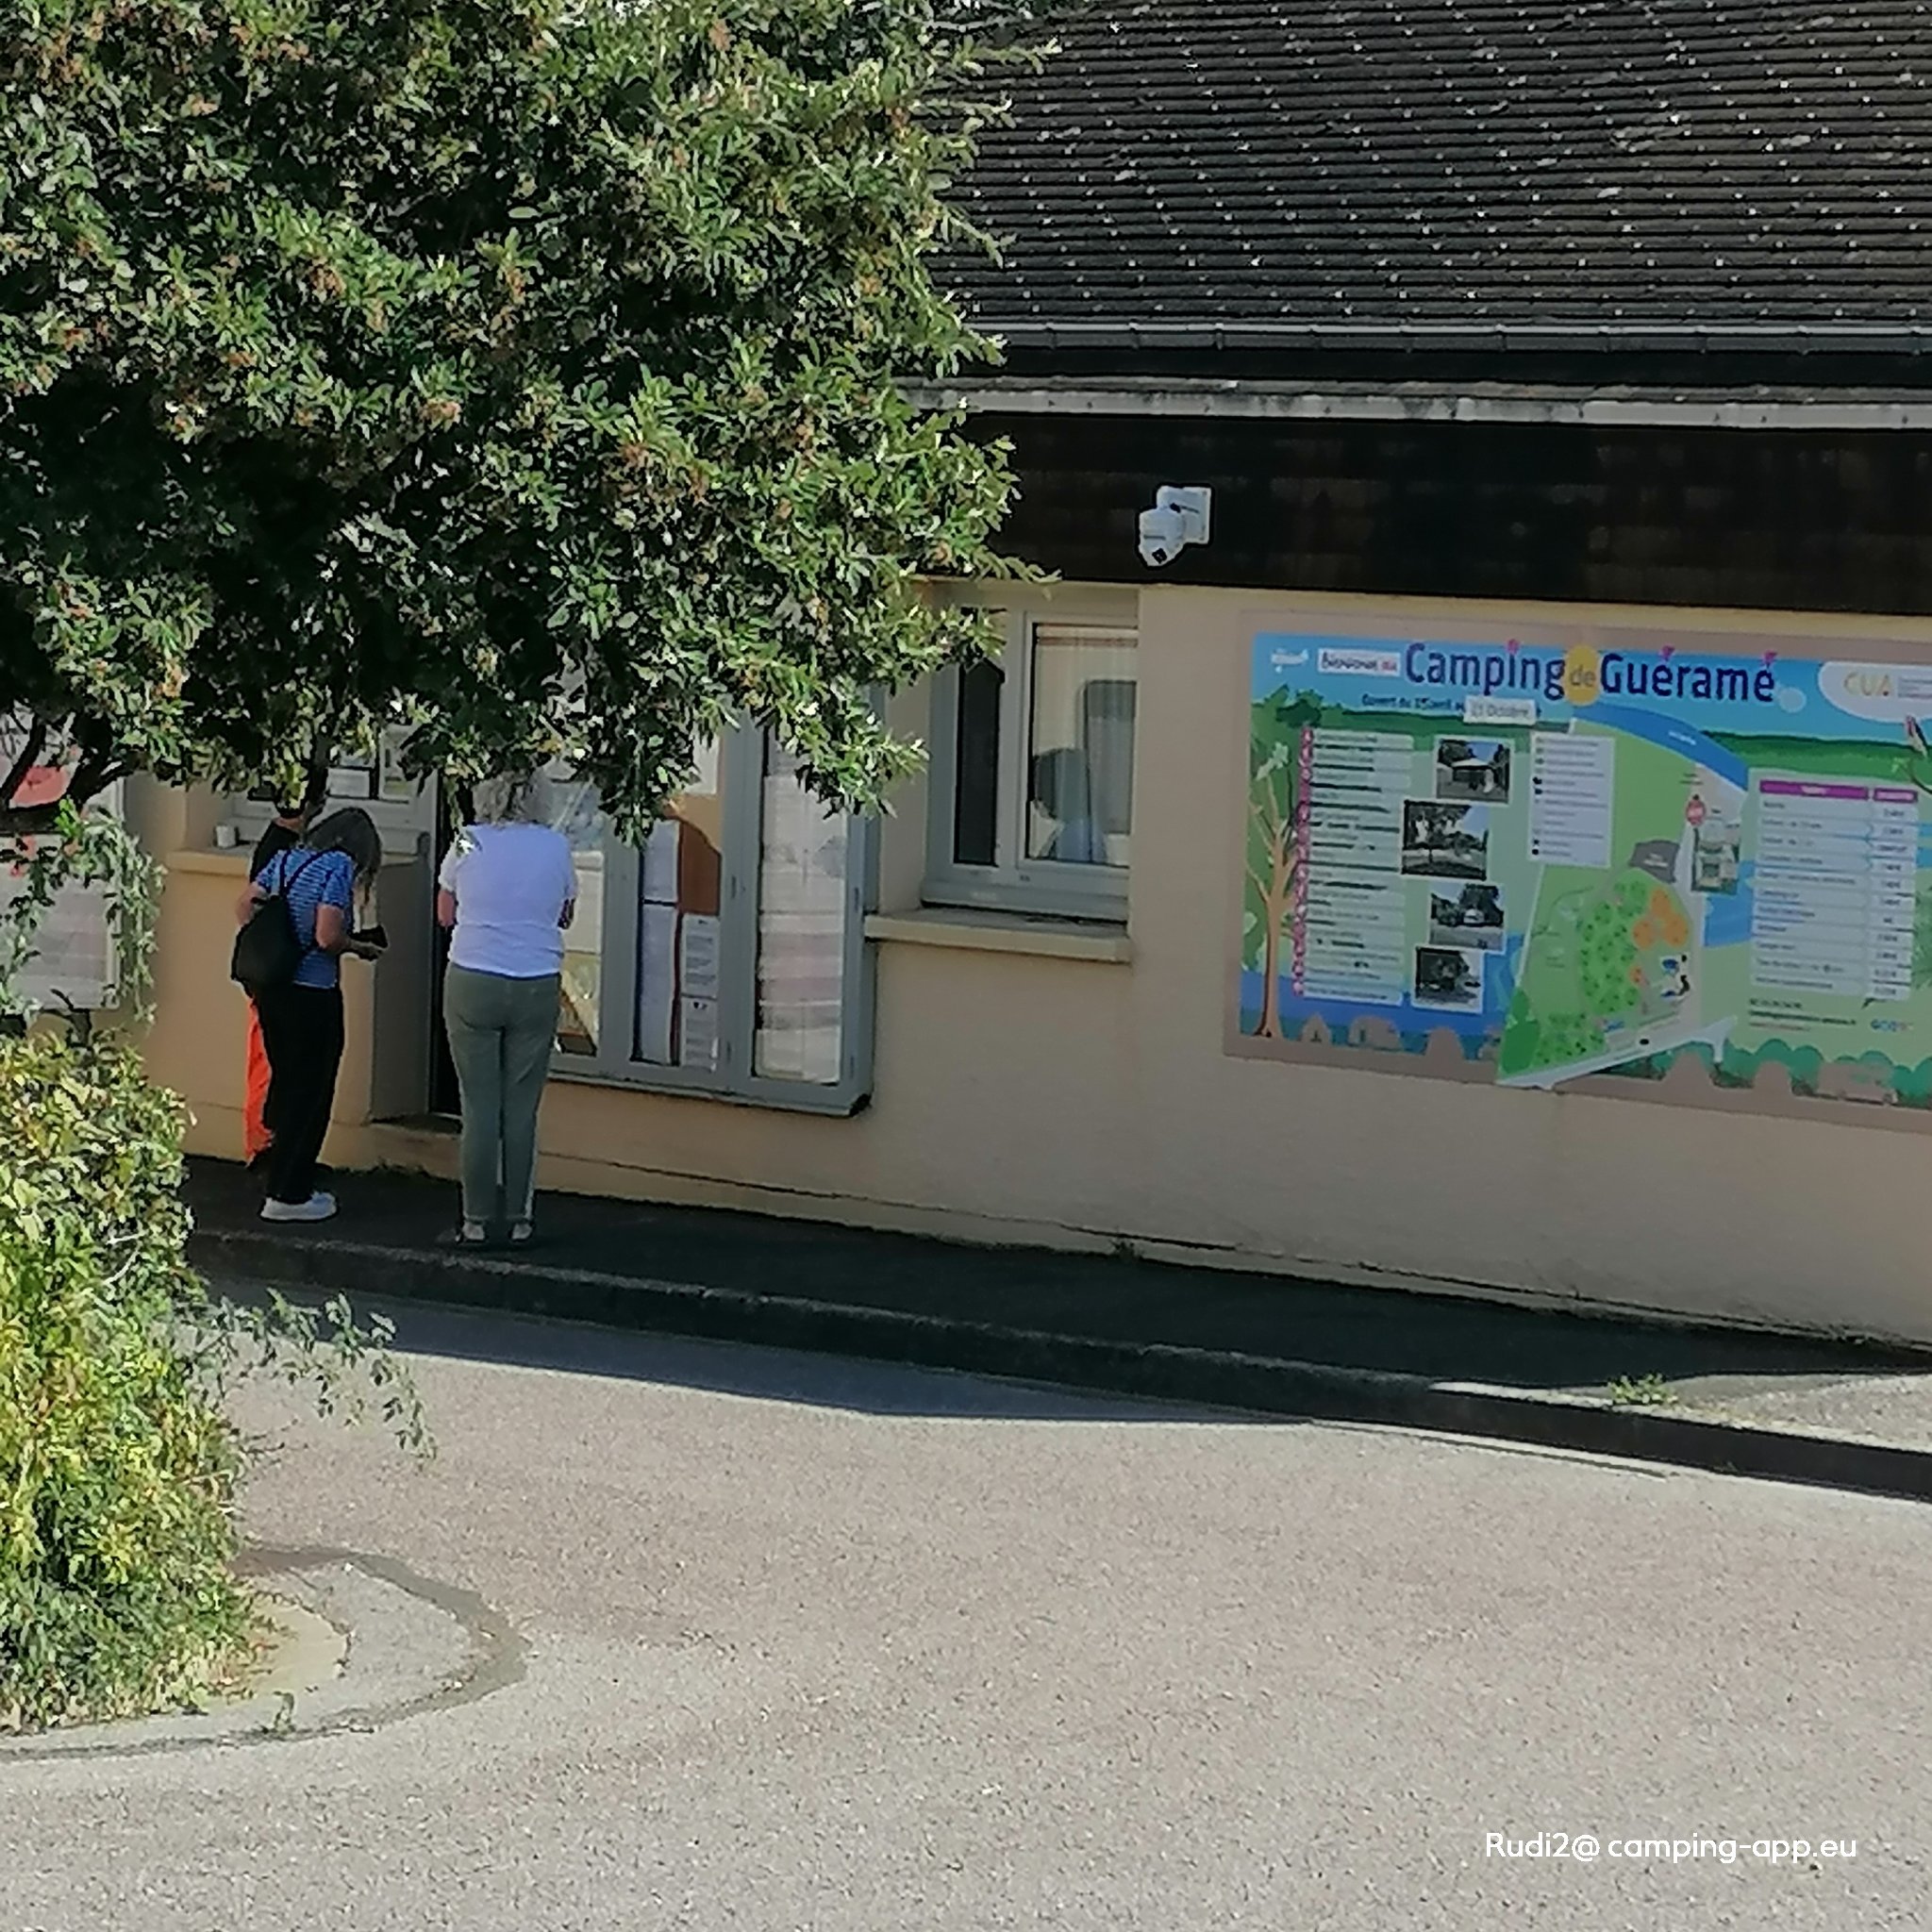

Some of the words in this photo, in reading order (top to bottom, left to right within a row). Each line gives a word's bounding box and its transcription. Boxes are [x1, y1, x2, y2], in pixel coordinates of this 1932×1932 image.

[1406, 641, 1565, 701] Camping
[1570, 667, 1596, 688] de
[1600, 645, 1777, 703] Guéramé
